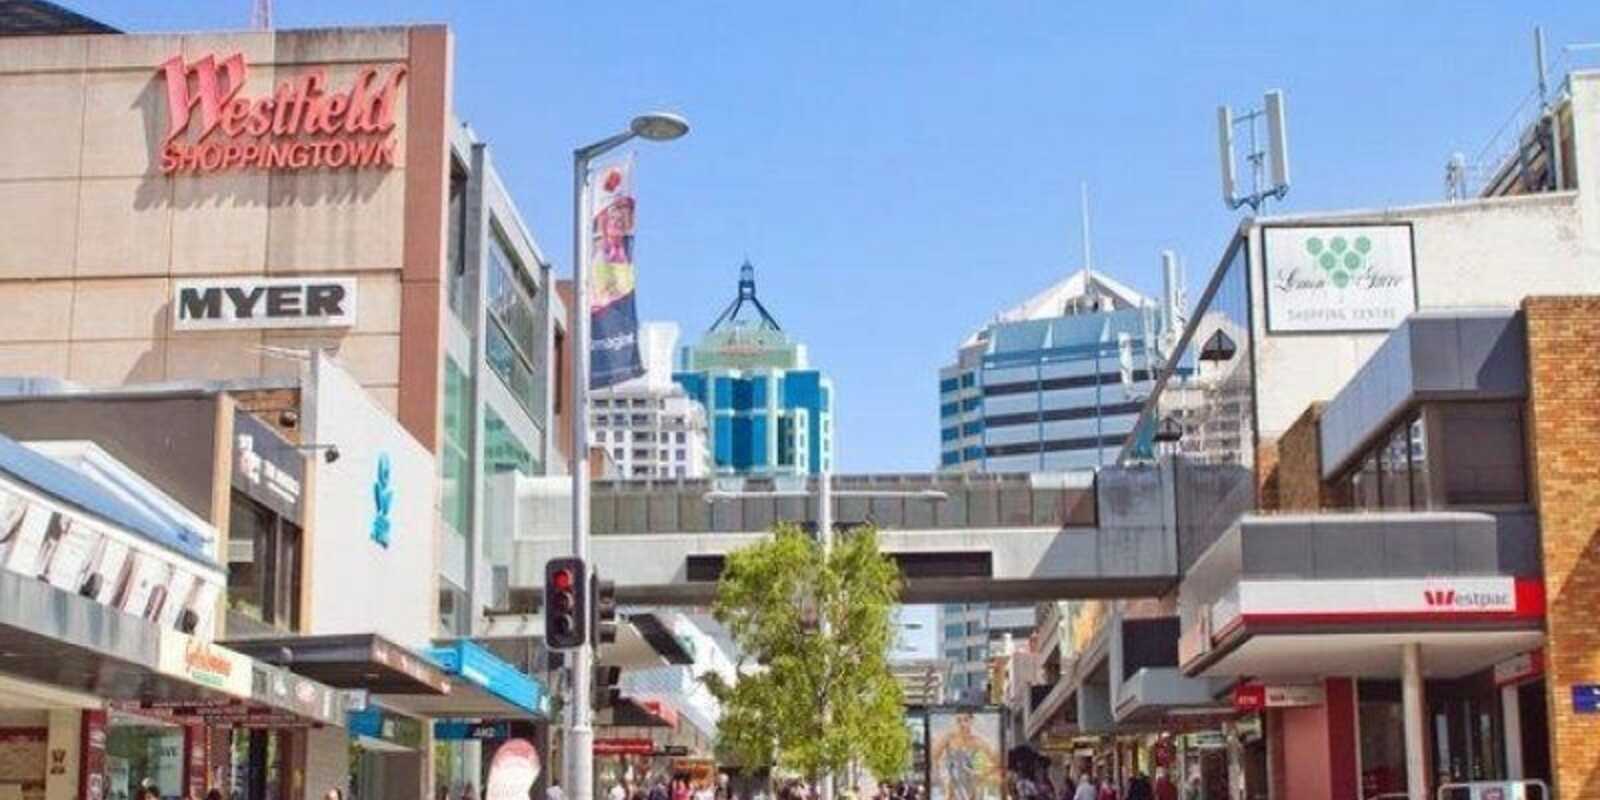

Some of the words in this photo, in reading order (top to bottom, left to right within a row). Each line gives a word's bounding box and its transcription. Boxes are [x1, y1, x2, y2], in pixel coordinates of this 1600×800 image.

[161, 53, 407, 145] Westfield
[160, 139, 397, 172] SHOPPINGTOWN
[180, 284, 346, 320] MYER
[1423, 590, 1510, 608] Westpac
